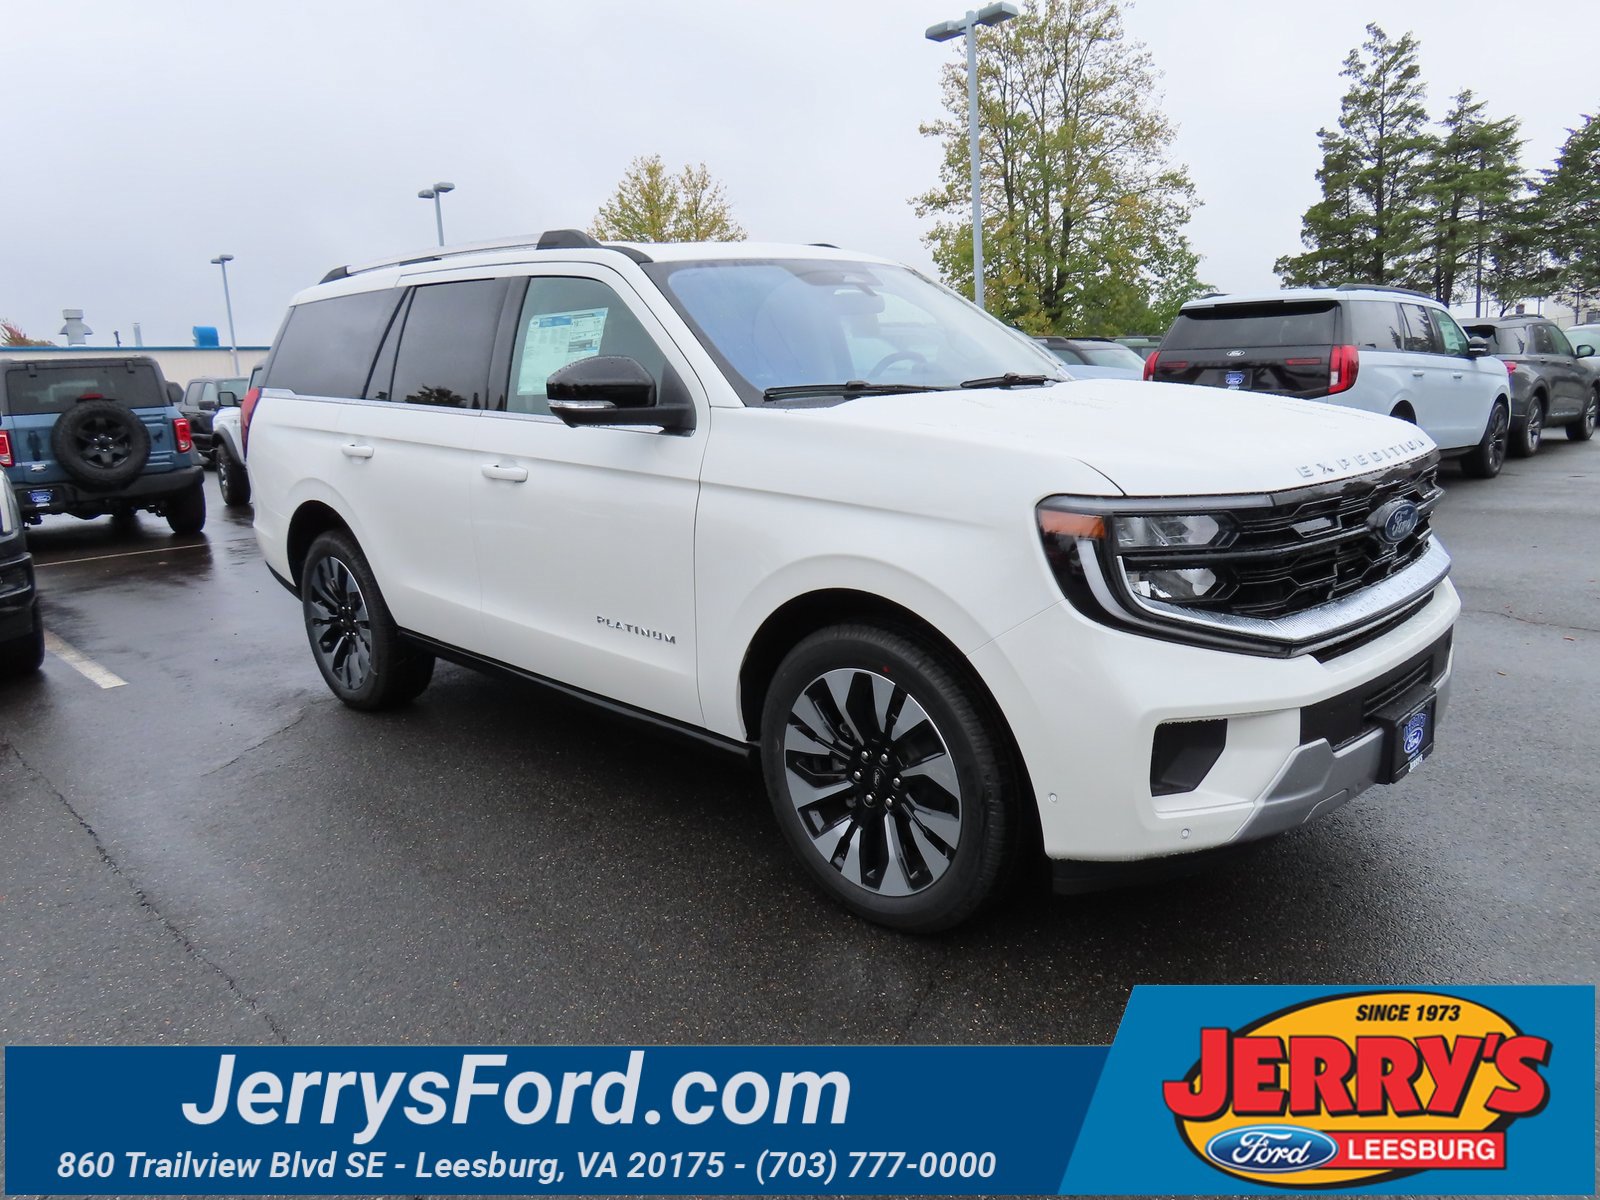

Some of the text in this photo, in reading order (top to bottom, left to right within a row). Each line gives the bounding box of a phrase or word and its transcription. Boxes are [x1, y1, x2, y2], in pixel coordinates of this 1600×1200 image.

[1296, 439, 1425, 478] EXPEDITION
[1390, 507, 1416, 539] Ford
[596, 616, 676, 644] PLATINUM
